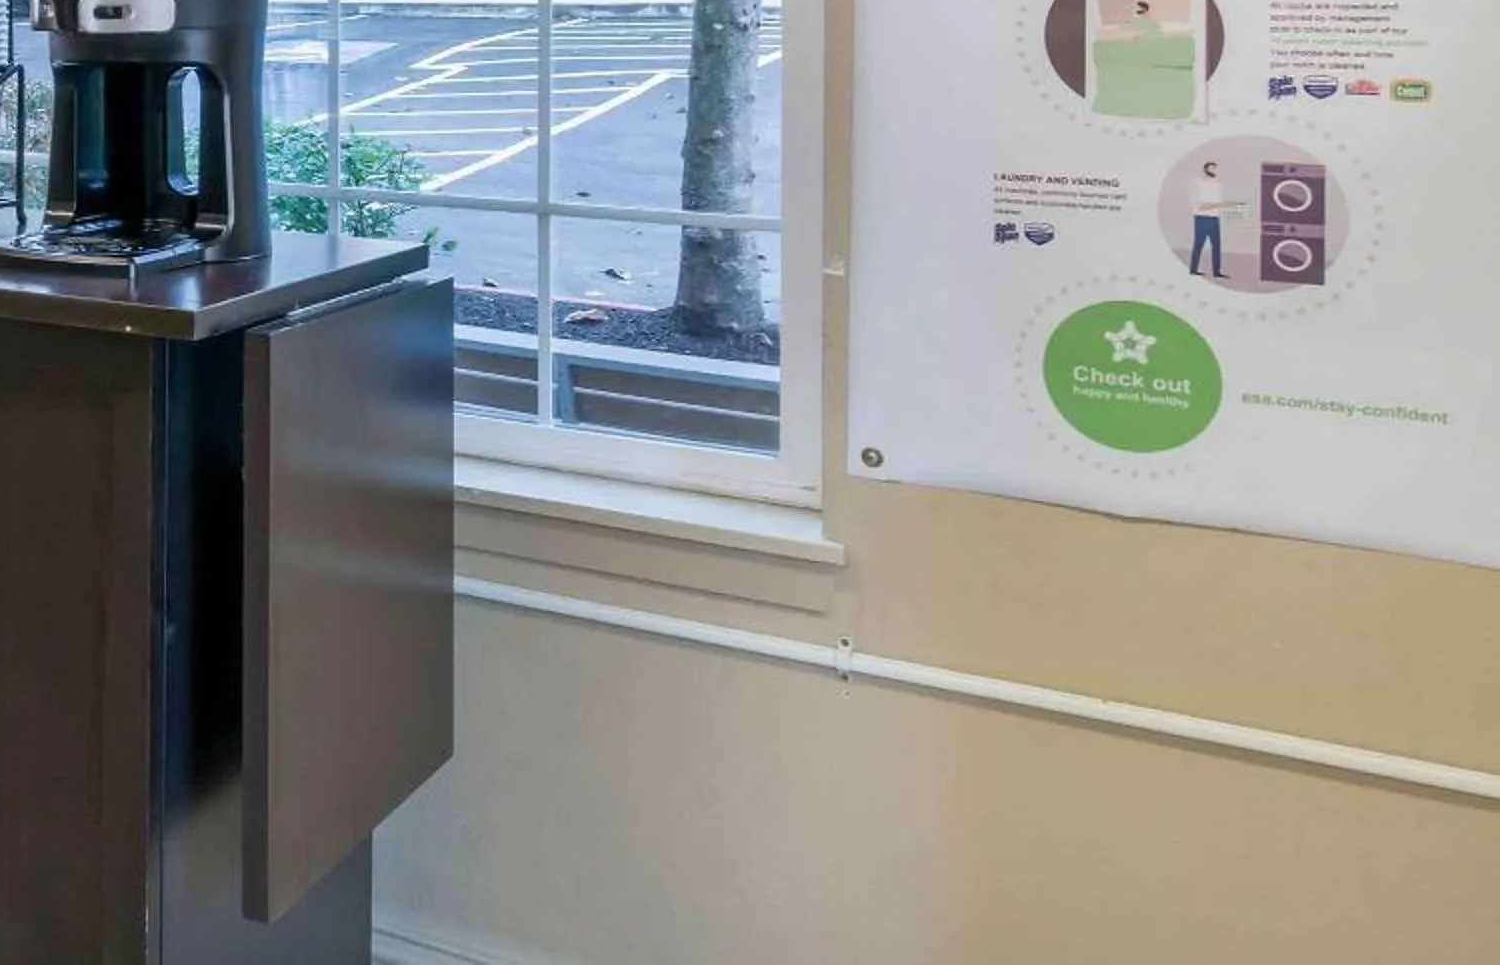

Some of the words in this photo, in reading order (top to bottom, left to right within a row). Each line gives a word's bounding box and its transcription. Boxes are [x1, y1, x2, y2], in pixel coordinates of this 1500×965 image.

[994, 173, 1042, 184] LAUNDRY
[1046, 176, 1069, 185] AND
[1073, 364, 1144, 388] Check
[1153, 375, 1191, 395] out
